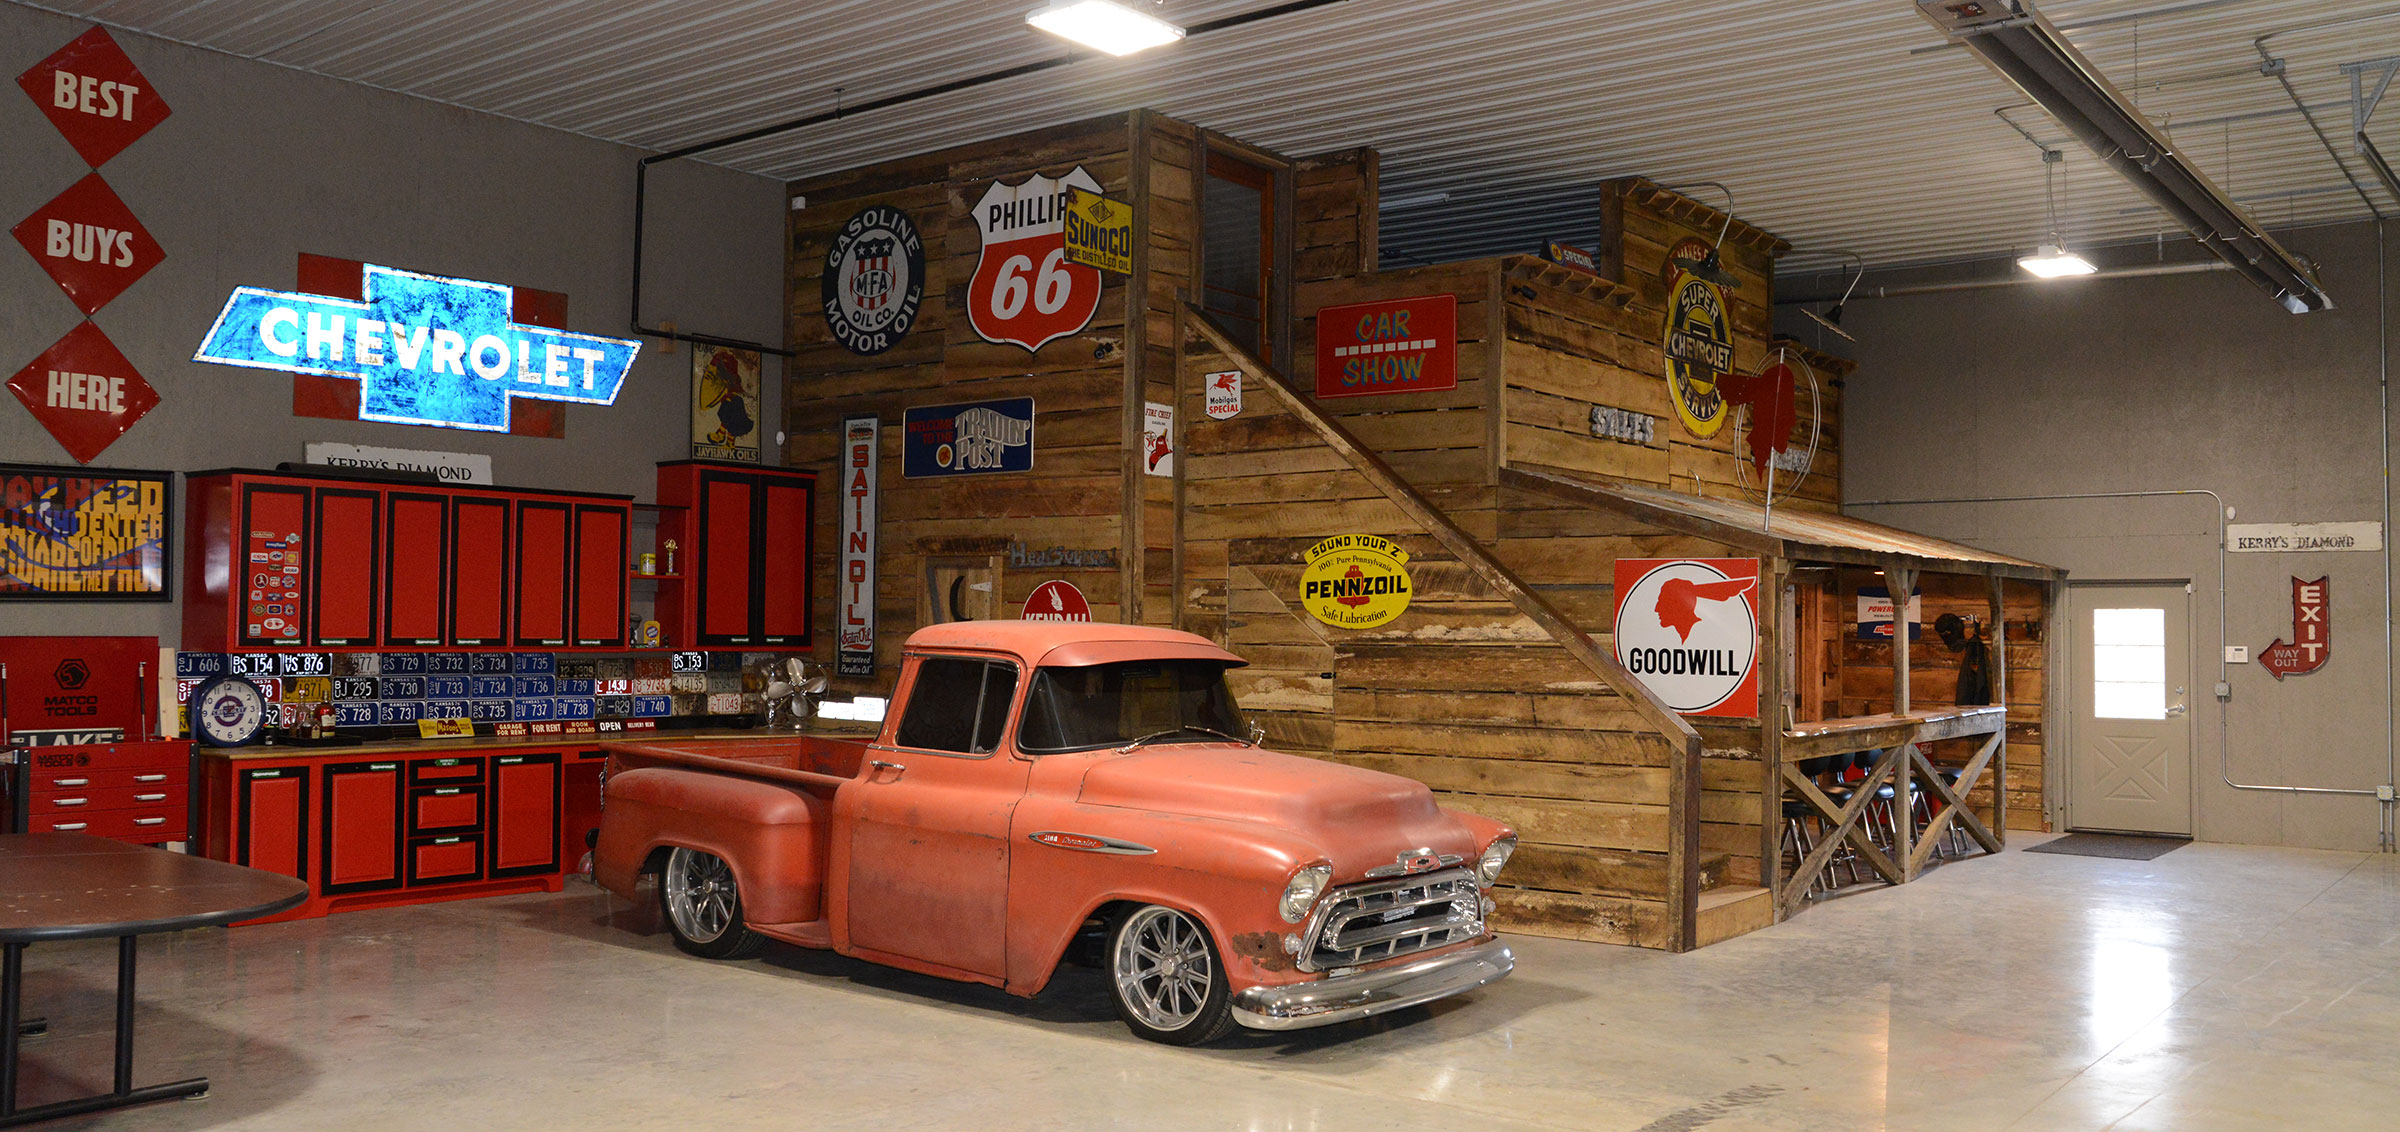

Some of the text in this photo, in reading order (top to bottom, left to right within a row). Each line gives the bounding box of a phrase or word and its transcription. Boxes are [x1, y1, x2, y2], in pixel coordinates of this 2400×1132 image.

[54, 70, 139, 121] BEST
[989, 191, 1067, 233] PHILLIP
[829, 209, 920, 268] GASOLINE
[1068, 210, 1130, 258] SUNOCO
[46, 219, 134, 268] BUYS
[1082, 249, 1117, 268] DISTILLED
[1118, 259, 1130, 271] OIL
[1563, 249, 1595, 269] SPECIAL
[991, 247, 1072, 320] 66
[1681, 284, 1721, 322] SUPER
[826, 287, 921, 352] MOTOR OIL
[852, 307, 894, 327] OIL CO.
[1356, 309, 1411, 342] CAR
[259, 306, 605, 391] CHEVROLET
[1671, 332, 1730, 370] CHEVROLET
[1341, 352, 1426, 387] SHOW
[47, 370, 126, 413] HERE
[1210, 396, 1237, 405] Mobilgas
[1146, 408, 1172, 419] FIRE CHIEF
[1209, 404, 1239, 414] SPECIAL
[908, 418, 954, 432] WELCOME
[955, 407, 1031, 446] TRADIN'
[1592, 407, 1655, 442] SALES
[922, 433, 934, 444] TO
[696, 446, 757, 462] JAYHAWK OILS
[954, 436, 1004, 470] POST
[397, 463, 472, 481] DIAMOND
[1312, 536, 1351, 557] SOUND
[1355, 536, 1387, 551] YOUR
[2238, 536, 2355, 549] KERRY'S DIAMOND
[1336, 556, 1351, 565] Pure
[1353, 555, 1392, 573] Pennsylvania
[1306, 575, 1408, 599] PENNZOIL
[1321, 605, 1388, 624] Safe Lubrication
[2300, 585, 2323, 662] EXIT
[2274, 649, 2299, 658] WAY
[199, 658, 220, 672] 606
[254, 657, 273, 673] 154
[304, 656, 324, 672] 876
[401, 657, 419, 670] 729
[446, 657, 464, 670] 732
[490, 658, 506, 670] 734
[533, 658, 548, 670] 735
[688, 654, 702, 668] 153
[1630, 647, 1740, 676] GOODWILL
[2274, 658, 2299, 667] OUT
[353, 682, 372, 697] 295
[400, 682, 418, 695] 730
[446, 681, 464, 695] 733
[490, 681, 506, 694] 734
[533, 681, 549, 693] 736
[573, 680, 588, 692] 739
[44, 696, 98, 705] MATCO
[651, 700, 665, 713] 740
[45, 706, 98, 716] TOOLS
[353, 708, 371, 722] 728
[400, 708, 416, 720] 731
[445, 706, 463, 719] 733
[490, 705, 506, 718] 735
[532, 704, 548, 717] 737
[573, 702, 589, 715] 738
[532, 723, 561, 733] FOR RENT
[600, 722, 622, 731] OPEN
